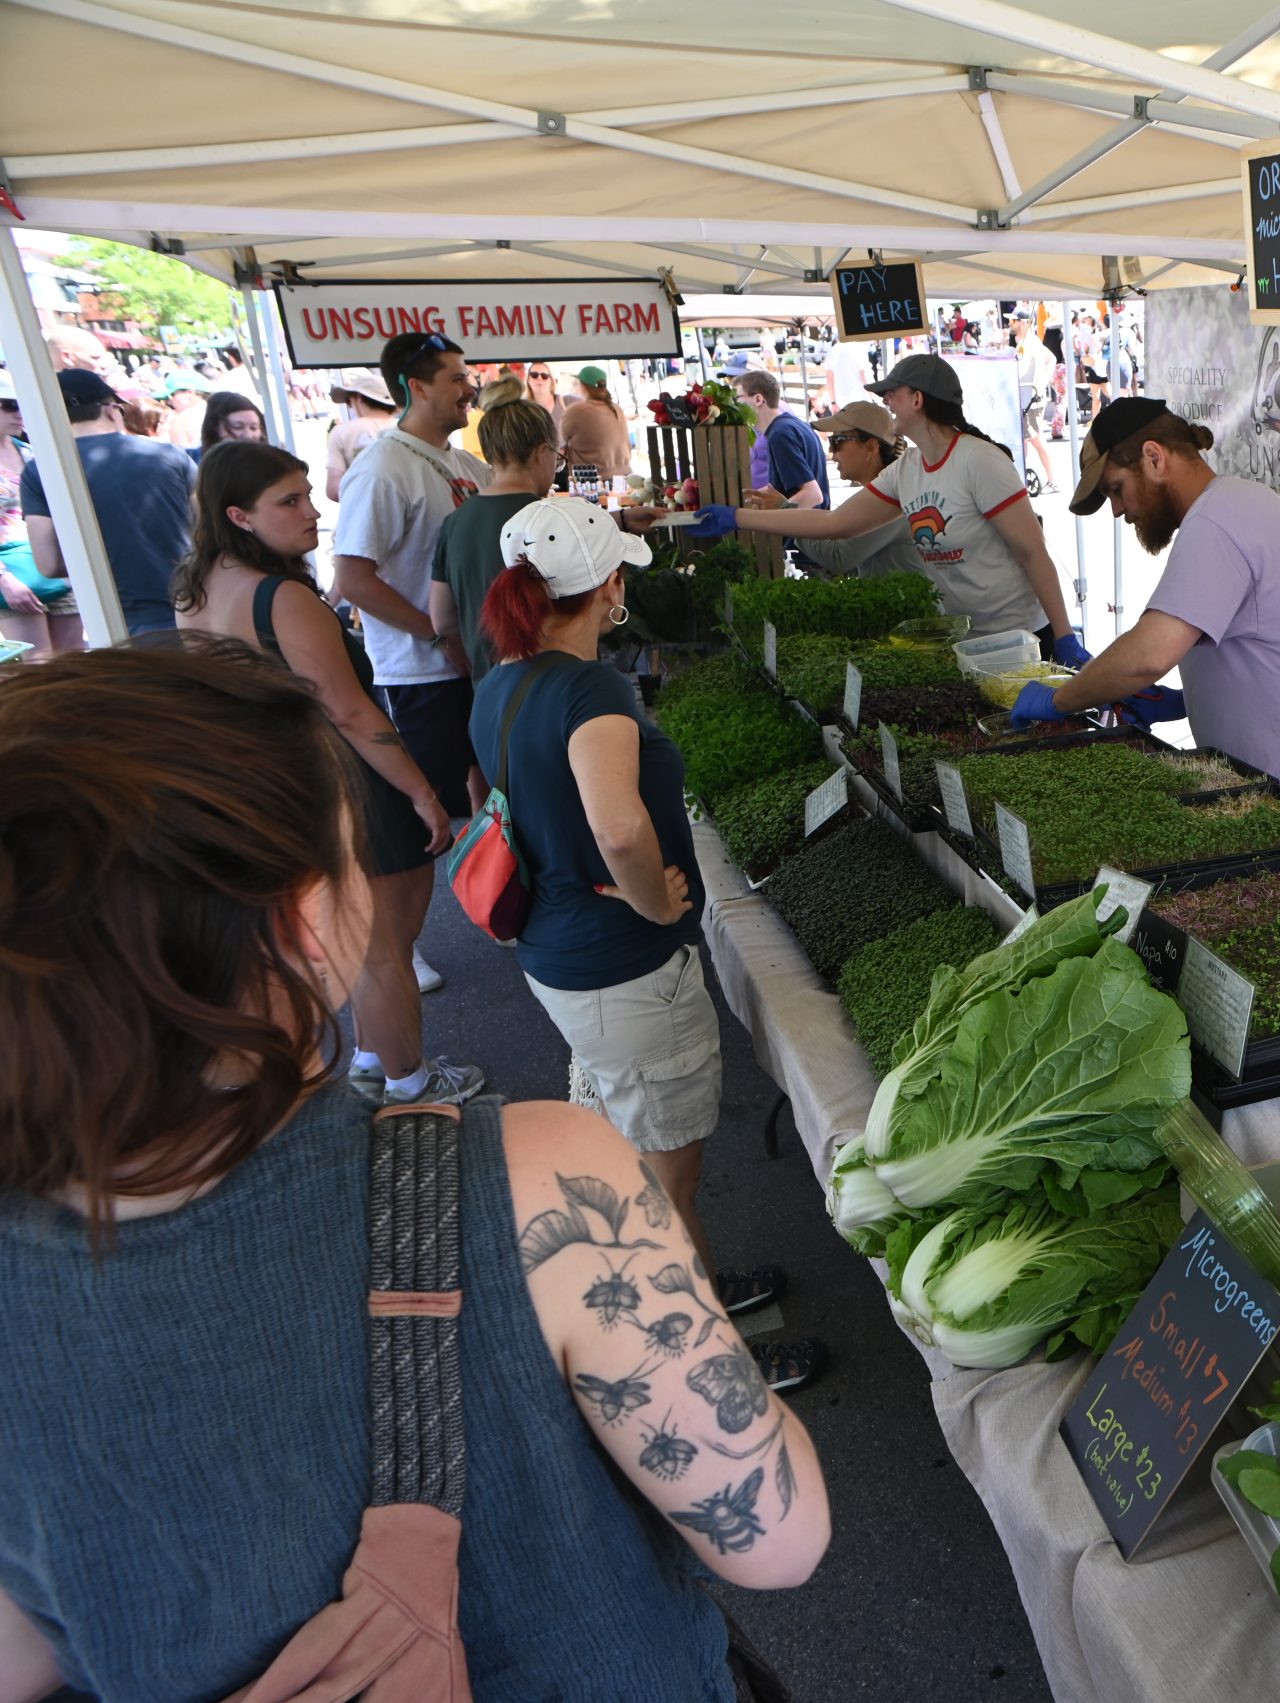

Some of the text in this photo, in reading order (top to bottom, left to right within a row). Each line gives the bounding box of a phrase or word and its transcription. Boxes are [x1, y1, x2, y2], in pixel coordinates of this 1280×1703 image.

[840, 267, 887, 295] PAY
[302, 302, 661, 340] UNSUNG FAMILY FARM
[860, 299, 919, 328] HERE
[1168, 367, 1226, 386] SPECIALITY
[1136, 931, 1162, 966] Napa
[1181, 1226, 1277, 1345] Microgreens
[1150, 1290, 1229, 1405] Small $7
[1113, 1336, 1198, 1454] Medium $13
[1085, 1379, 1162, 1499] Large $23
[1085, 1437, 1134, 1518] (best value)
